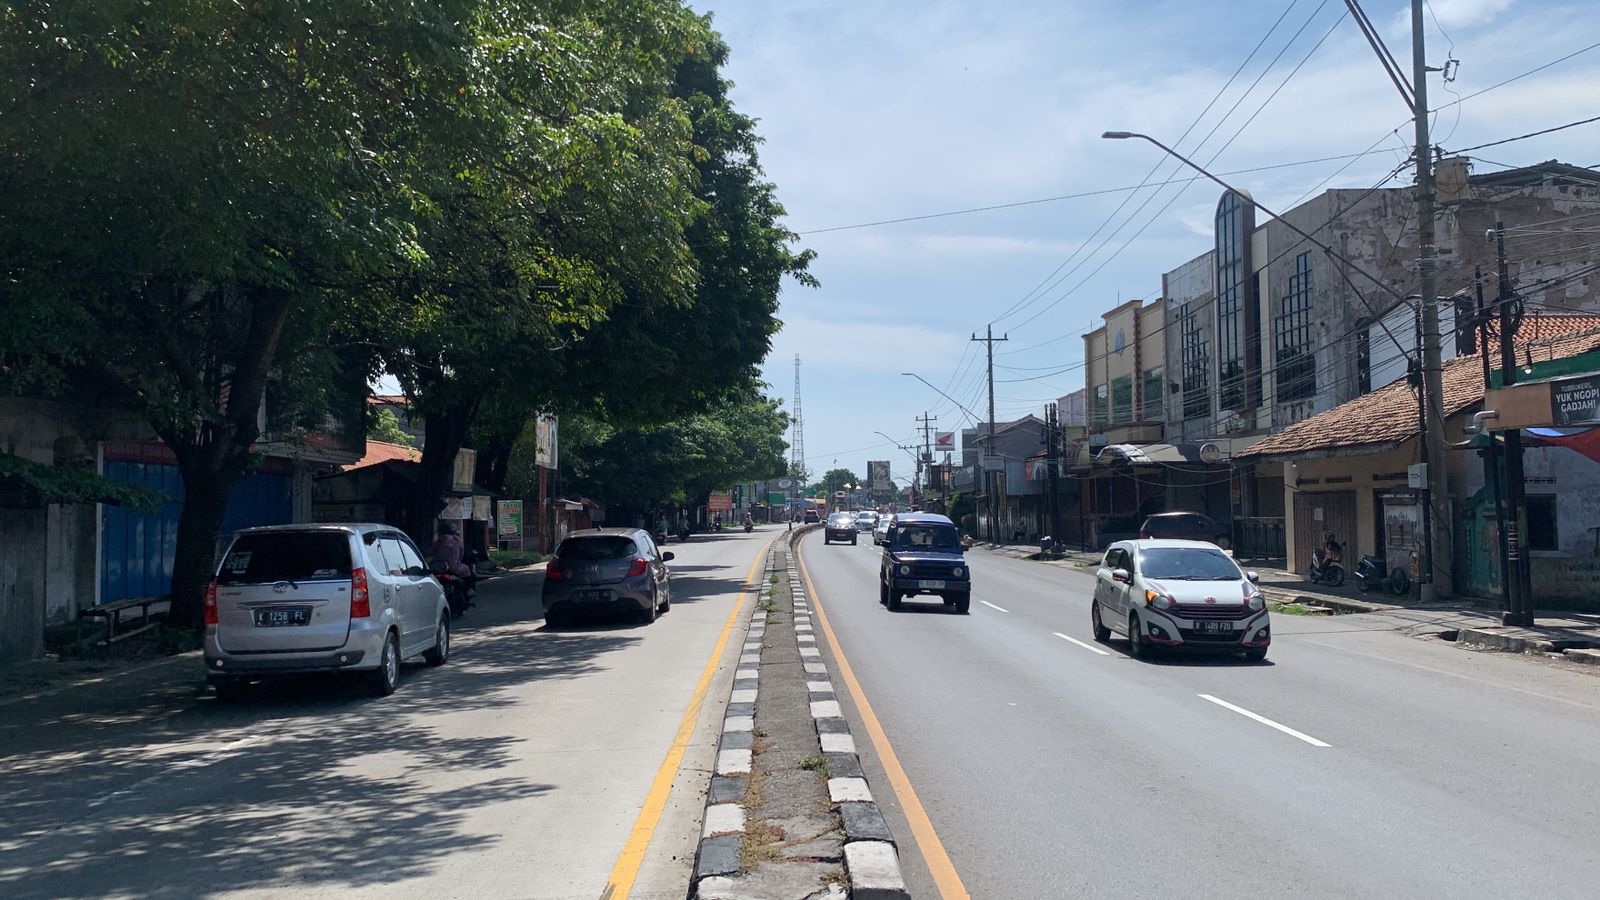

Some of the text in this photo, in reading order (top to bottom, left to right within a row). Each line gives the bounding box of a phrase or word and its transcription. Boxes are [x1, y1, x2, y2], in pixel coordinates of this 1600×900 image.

[1555, 388, 1600, 403] YUK NGOPI
[1561, 399, 1596, 412] GADJAH!
[294, 611, 305, 620] FL
